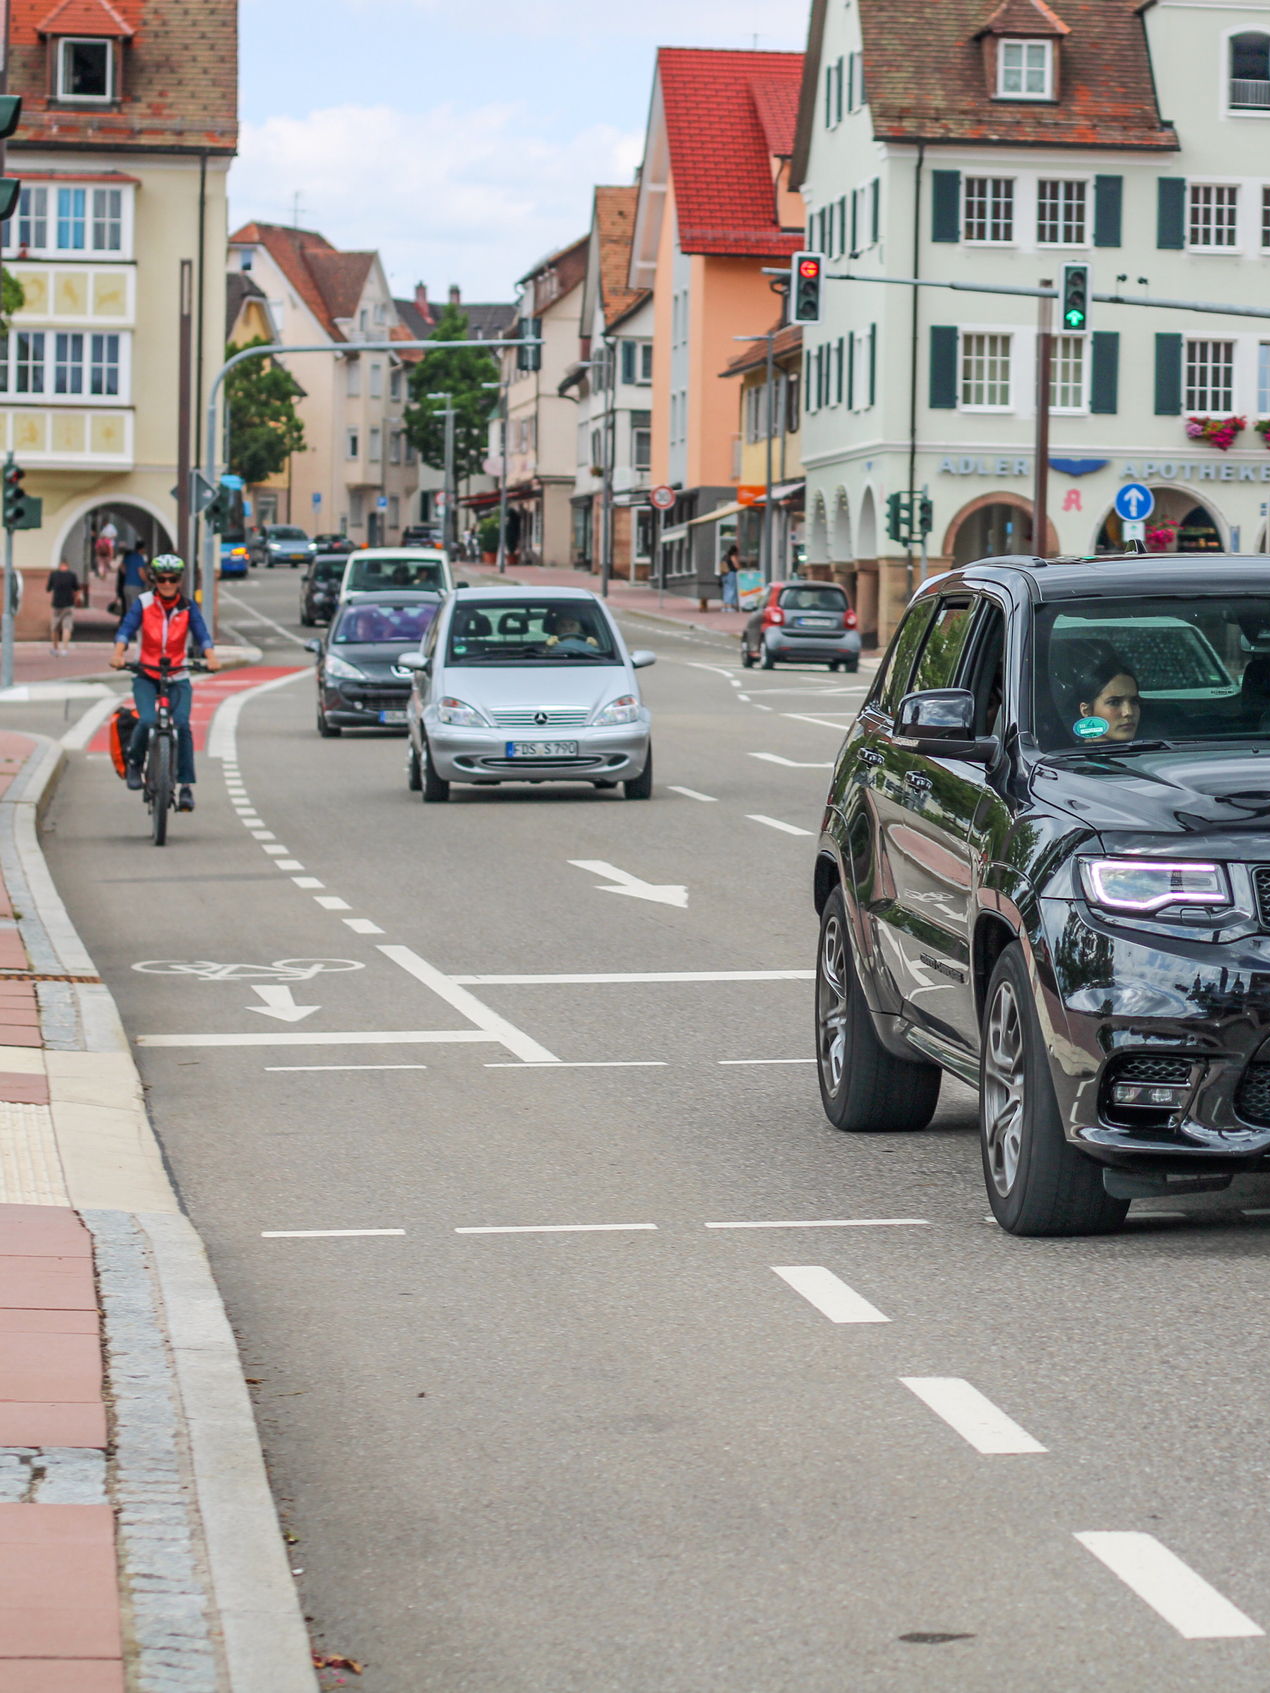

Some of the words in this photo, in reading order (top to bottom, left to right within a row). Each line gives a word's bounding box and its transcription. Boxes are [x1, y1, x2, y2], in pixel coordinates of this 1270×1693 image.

[938, 457, 1030, 475] ADLER
[514, 744, 536, 754] FDS
[544, 744, 552, 754] S
[554, 743, 576, 754] 790
